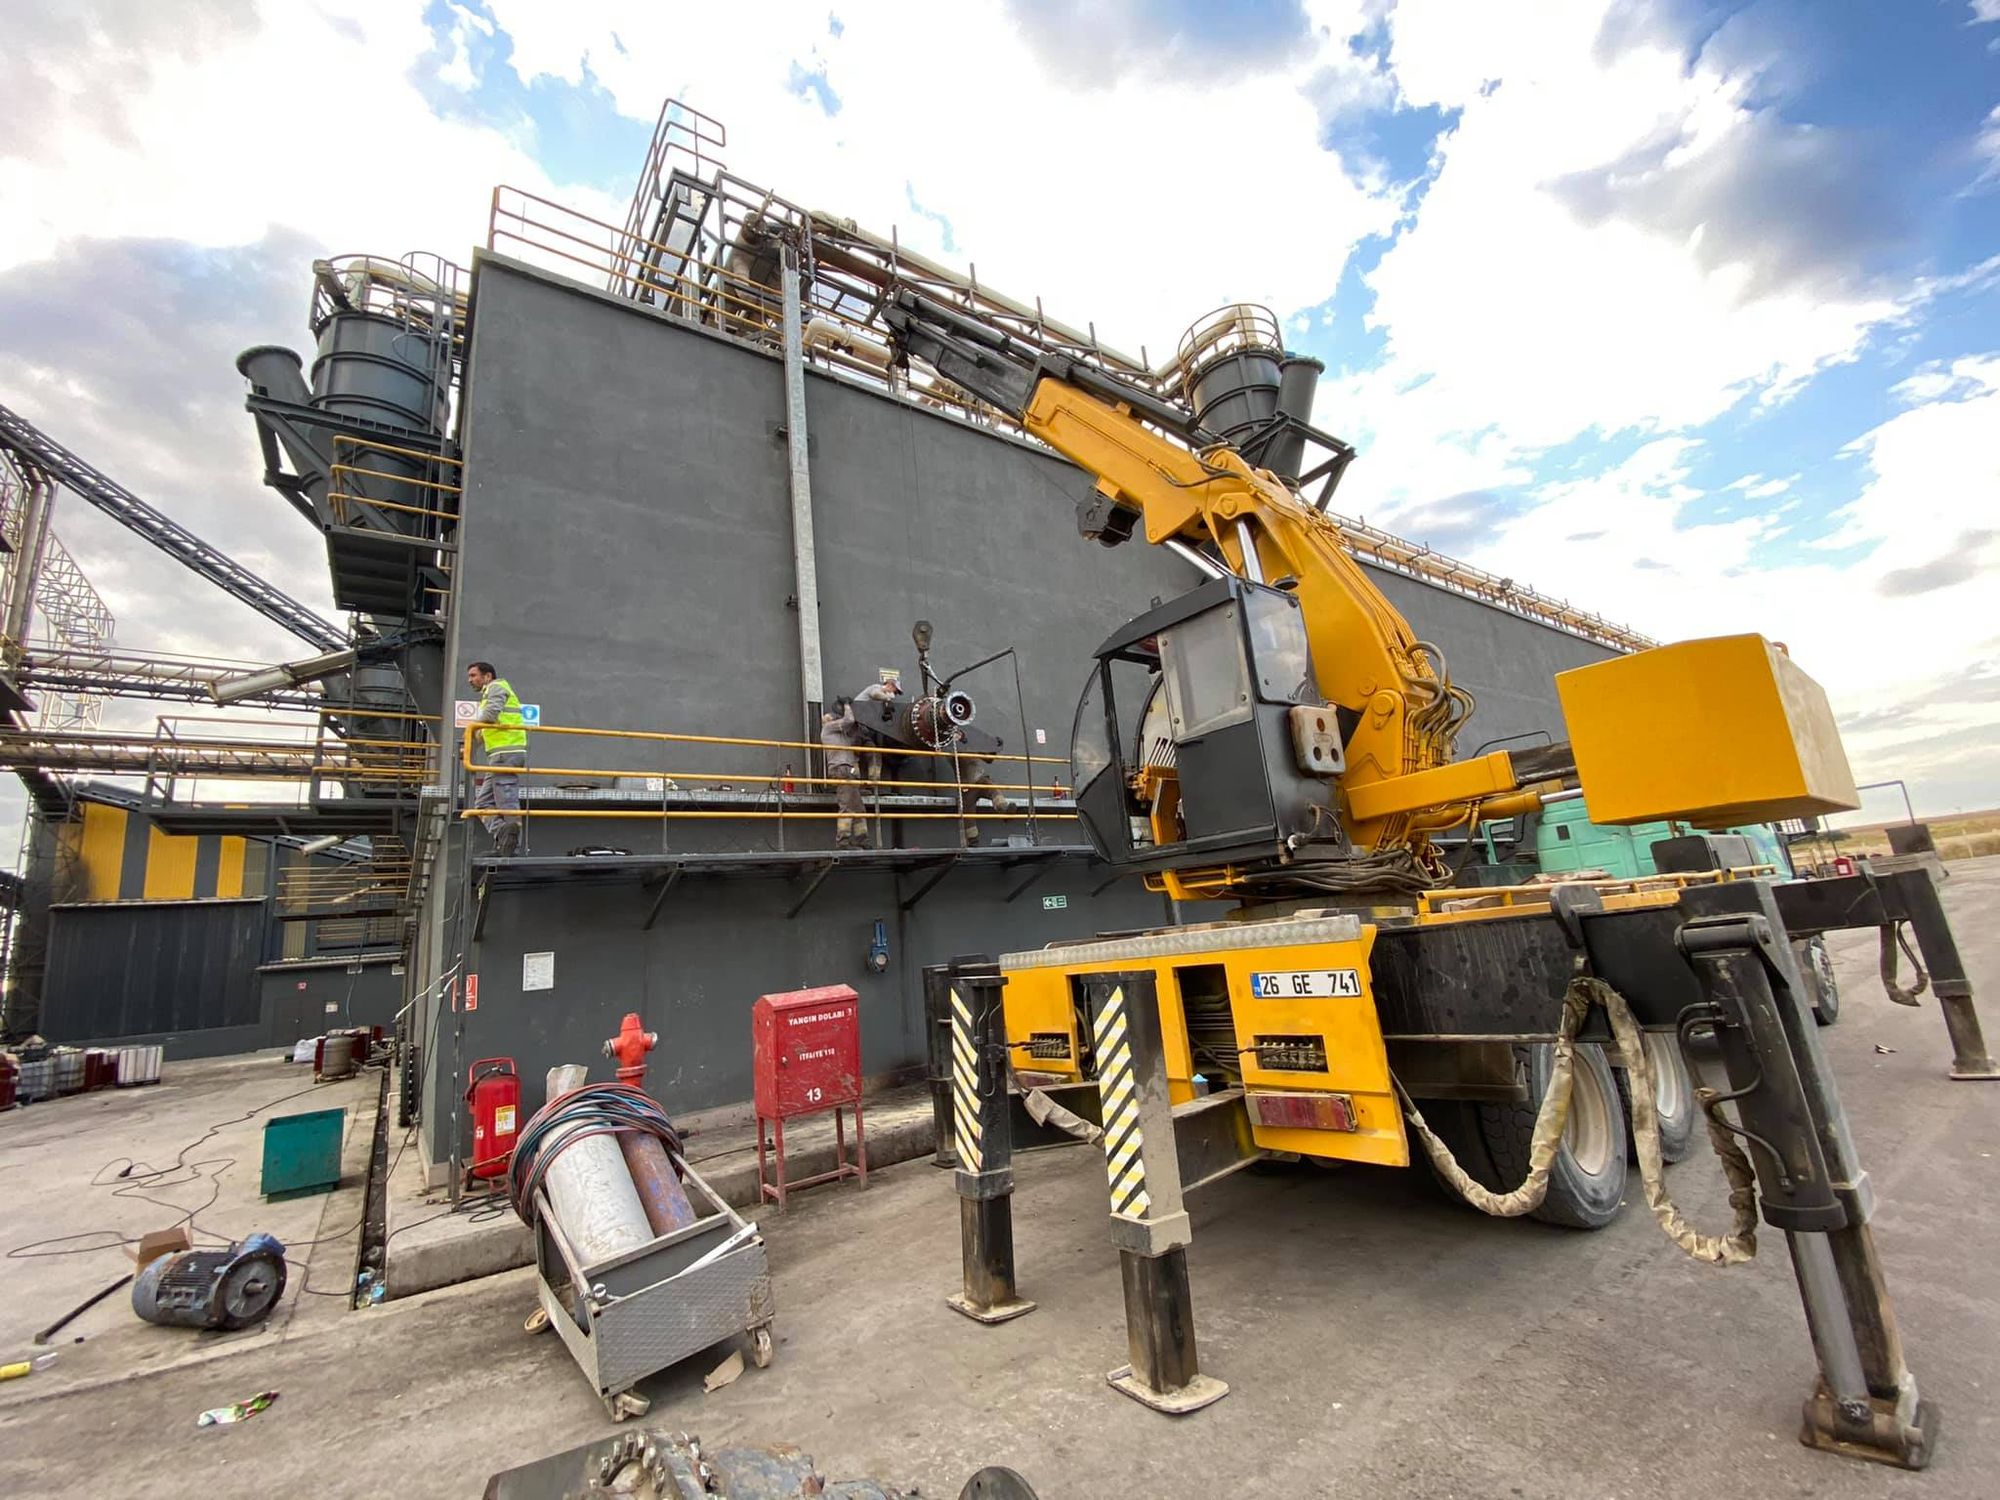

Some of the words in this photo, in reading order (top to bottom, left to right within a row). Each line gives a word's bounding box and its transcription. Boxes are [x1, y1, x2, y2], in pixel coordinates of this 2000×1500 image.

[1261, 975, 1280, 995] 26
[1292, 974, 1313, 994] GE
[1327, 972, 1359, 994] 741
[788, 1014, 817, 1026] YANGIN
[818, 1010, 845, 1021] DOLABI
[806, 1087, 822, 1102] 13
